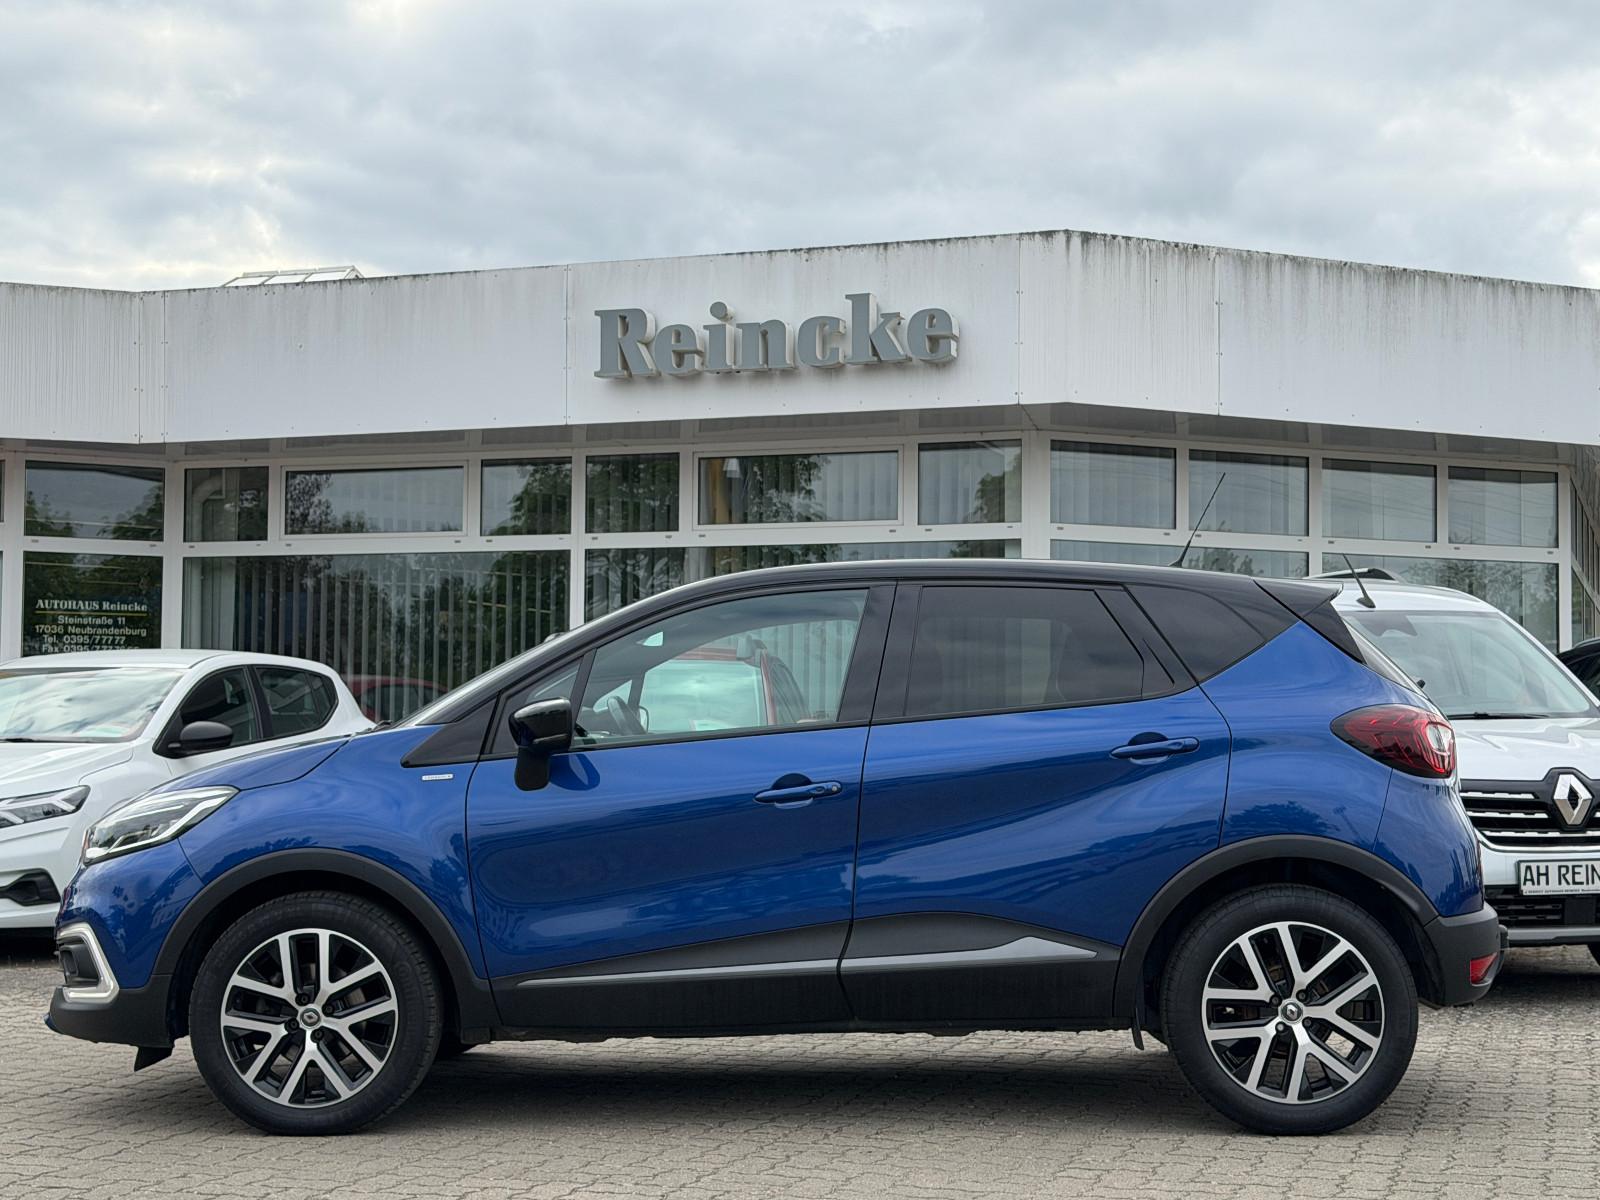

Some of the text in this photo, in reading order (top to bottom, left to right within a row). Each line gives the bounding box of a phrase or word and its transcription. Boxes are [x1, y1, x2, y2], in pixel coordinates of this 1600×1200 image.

[594, 293, 960, 380] Reincke
[35, 599, 148, 612] AUTOHAUS Reincke
[57, 615, 126, 625] Steinstraße 11
[35, 625, 147, 637] 17036 Neubrandenburg
[42, 635, 59, 644] Tel.
[42, 645, 60, 653] Fax
[1523, 864, 1600, 886] AH REIN
